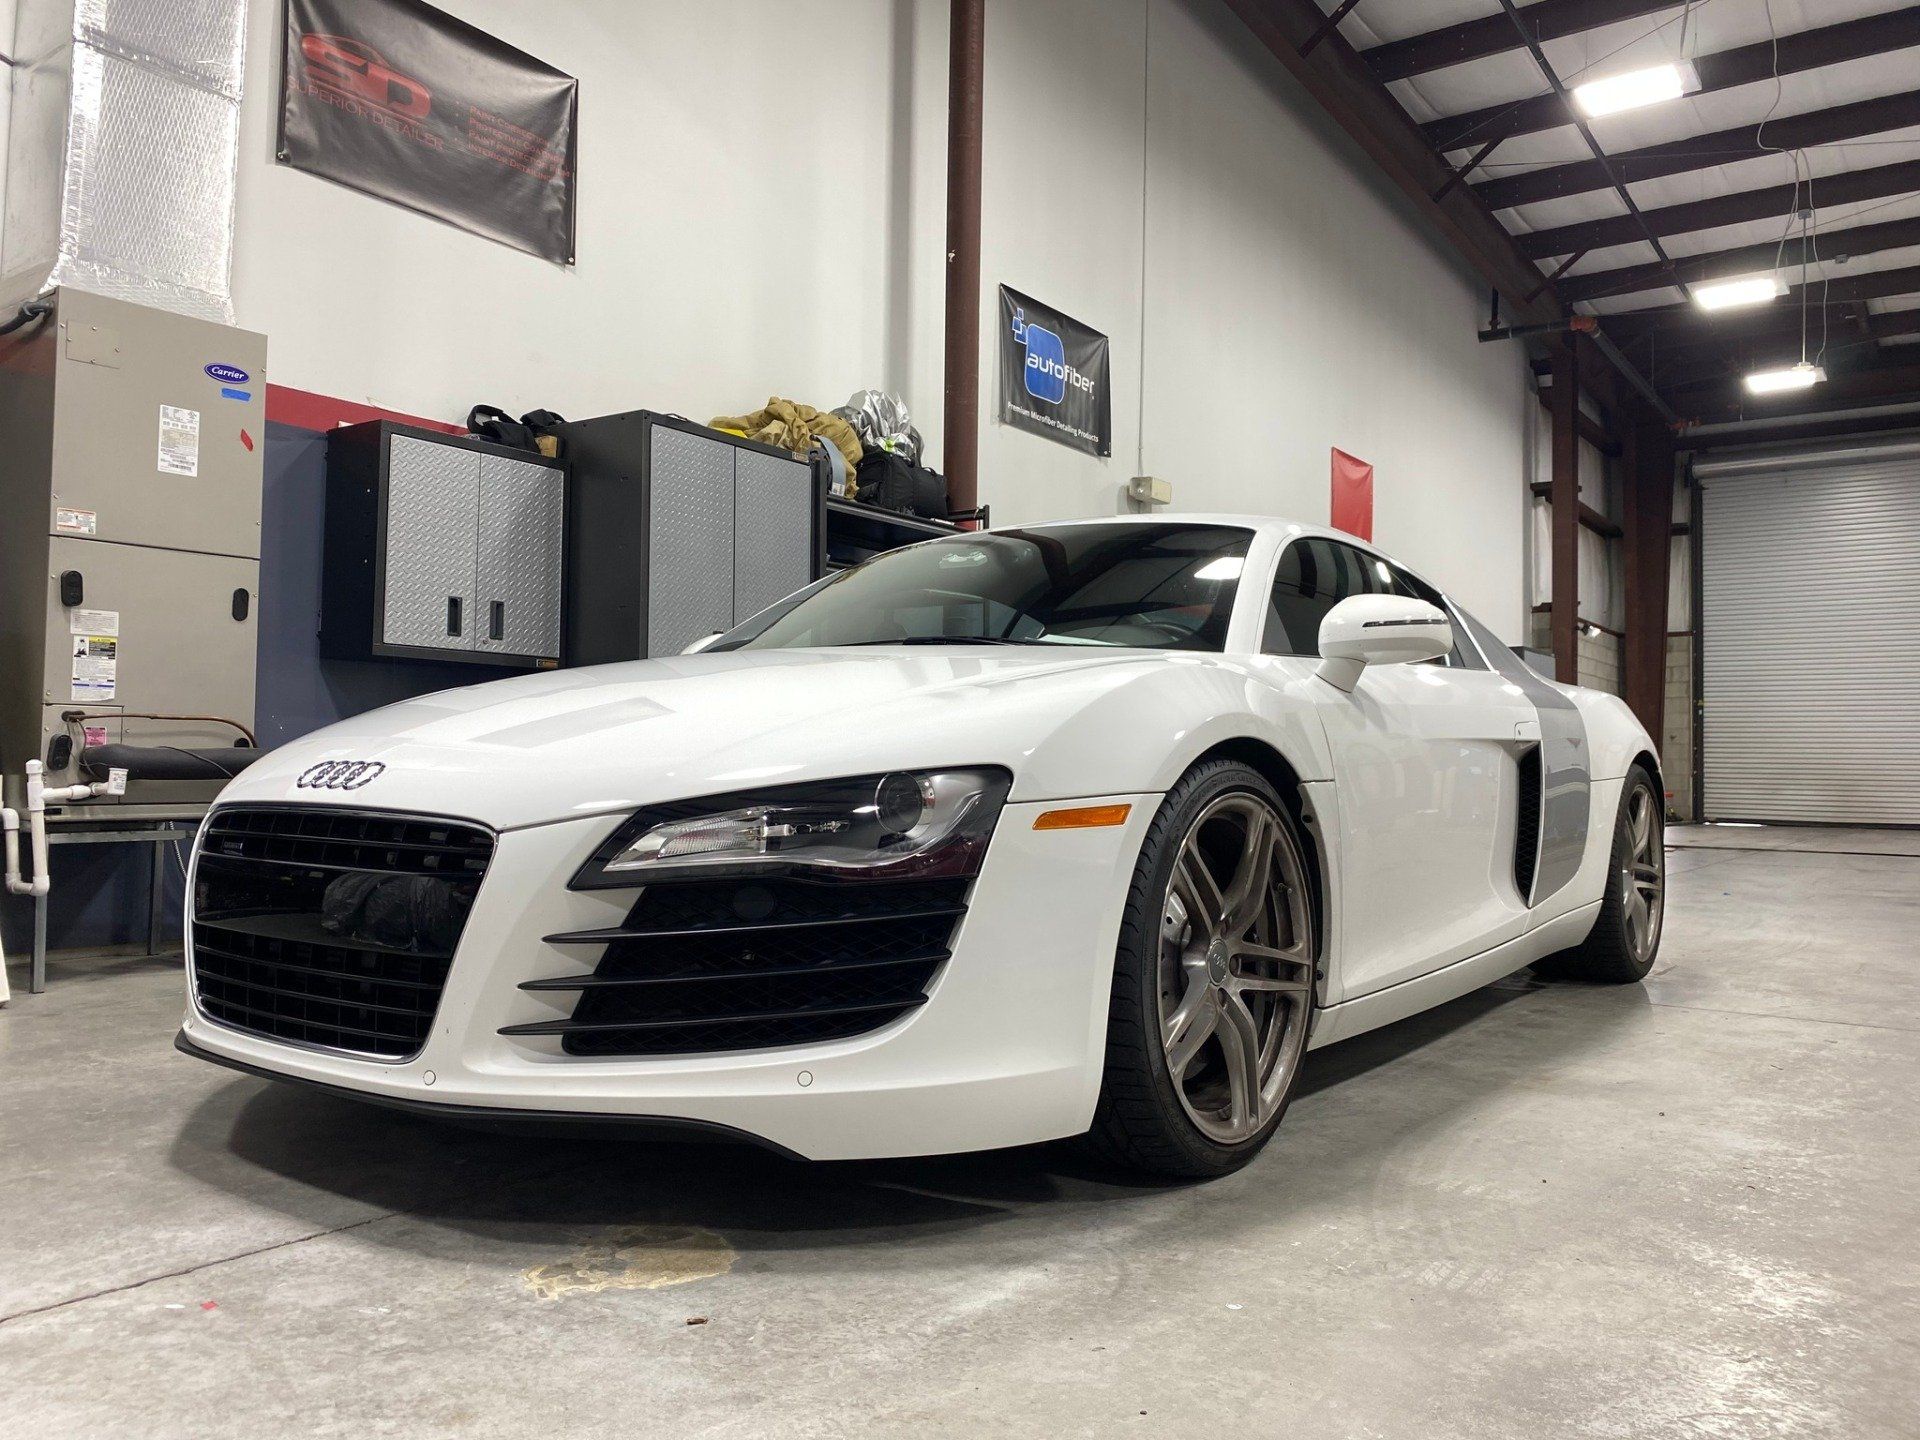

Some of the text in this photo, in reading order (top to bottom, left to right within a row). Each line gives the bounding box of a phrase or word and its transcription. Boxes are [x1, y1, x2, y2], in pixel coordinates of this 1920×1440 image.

[287, 75, 367, 120] SUPERIOR
[211, 366, 245, 380] Carrier
[1027, 352, 1095, 394] autofiber
[1007, 401, 1099, 442] Premium Microfiber Detailing Products
